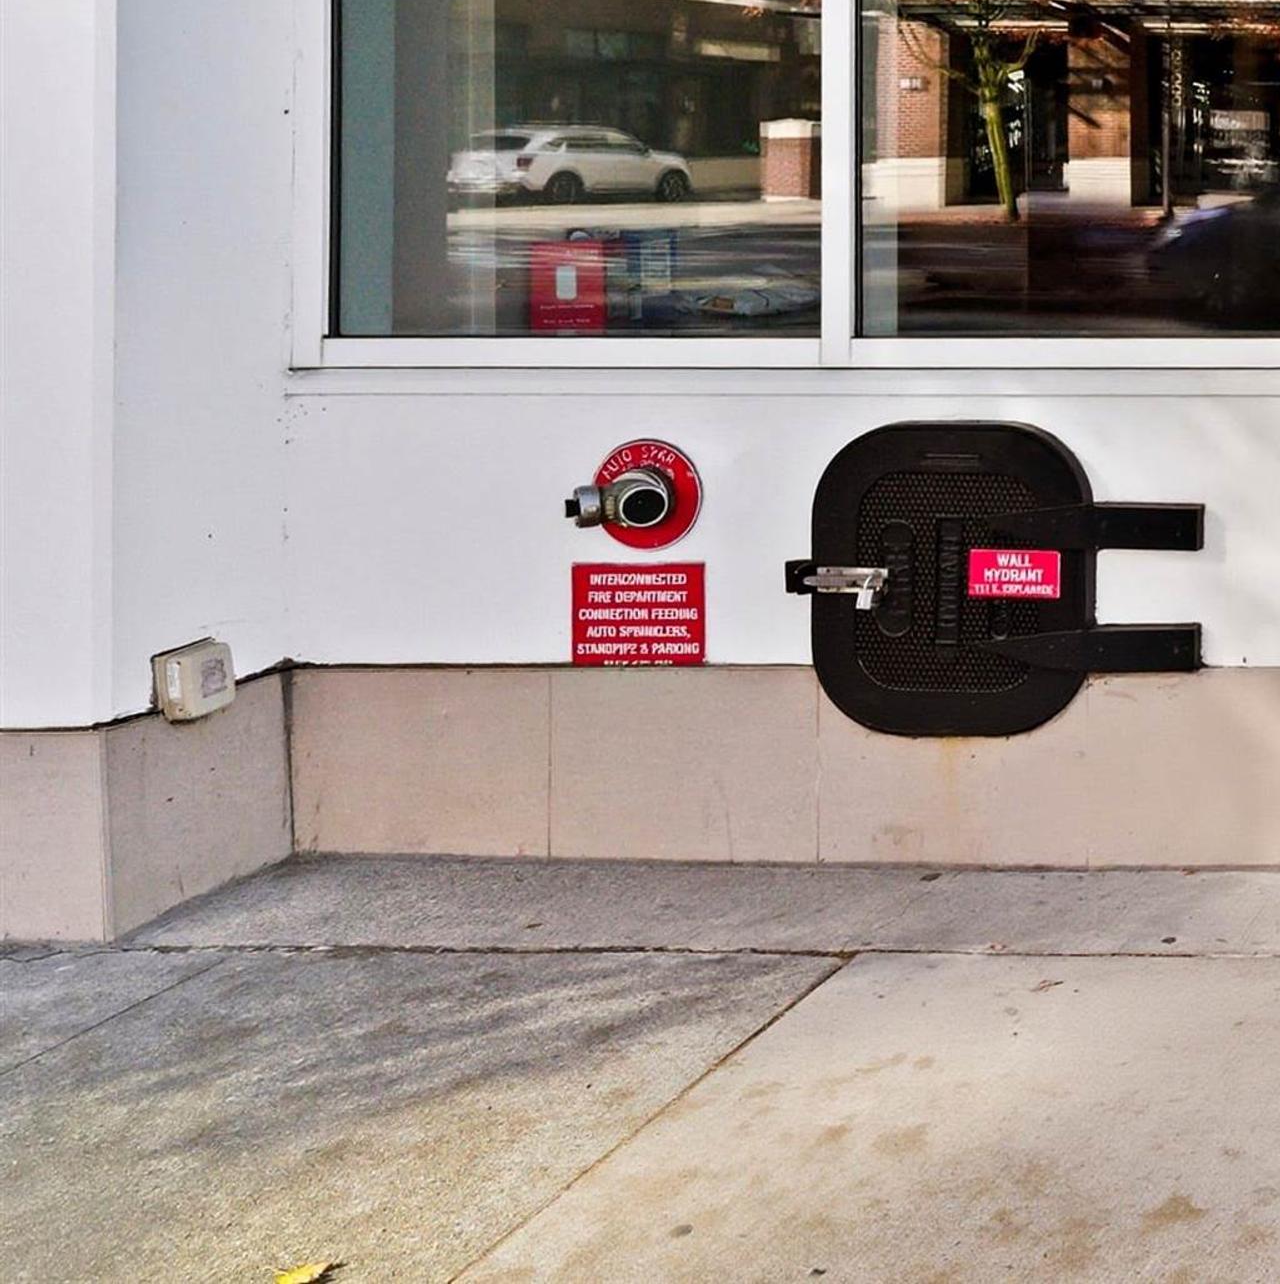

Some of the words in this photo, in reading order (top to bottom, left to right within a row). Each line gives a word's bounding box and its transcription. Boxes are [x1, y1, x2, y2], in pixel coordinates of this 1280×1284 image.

[602, 449, 632, 480] AUTO
[996, 553, 1032, 567] WALL
[590, 573, 687, 585] INTERCONNECTED
[984, 568, 1044, 583] HYDRANT
[588, 591, 611, 603] FIRE
[615, 590, 688, 603] DEPARTMENT
[579, 608, 649, 620] CONNECTION
[651, 608, 698, 620] FEEDING
[586, 625, 617, 638] AUTO
[640, 643, 649, 654] &
[652, 642, 700, 655] PARKING
